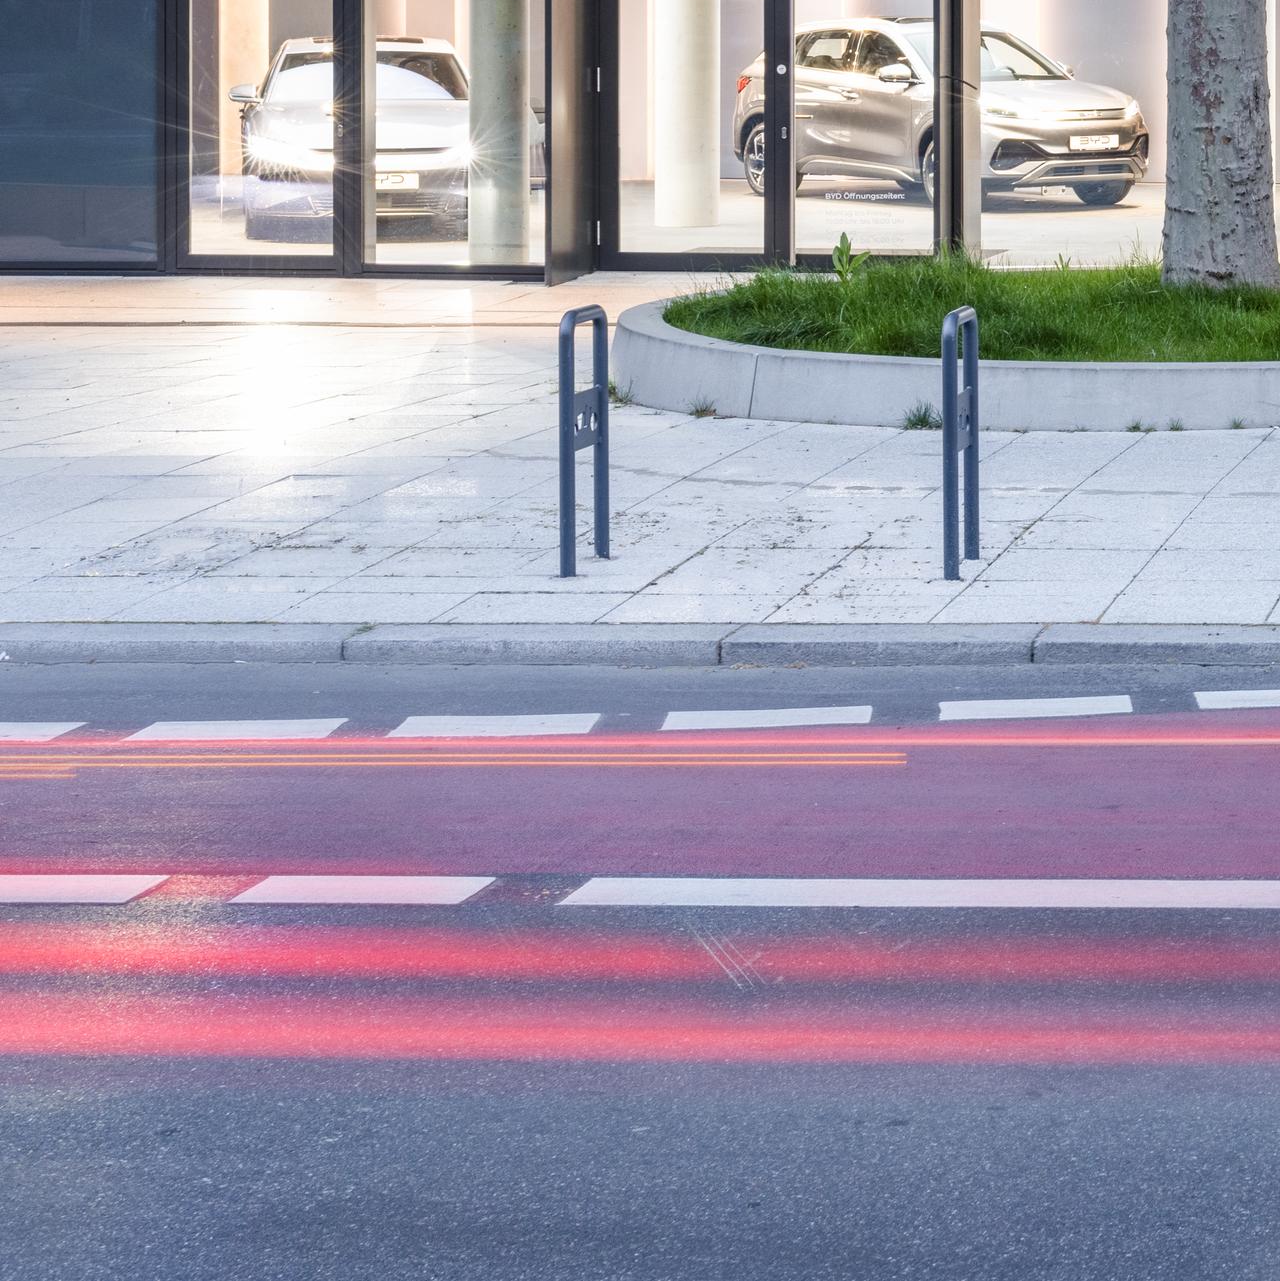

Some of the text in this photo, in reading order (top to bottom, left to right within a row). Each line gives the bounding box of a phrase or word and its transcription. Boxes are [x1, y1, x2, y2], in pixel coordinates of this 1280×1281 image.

[1080, 136, 1110, 145] BYD
[825, 192, 905, 201] BYD Öffnungszeiten:
